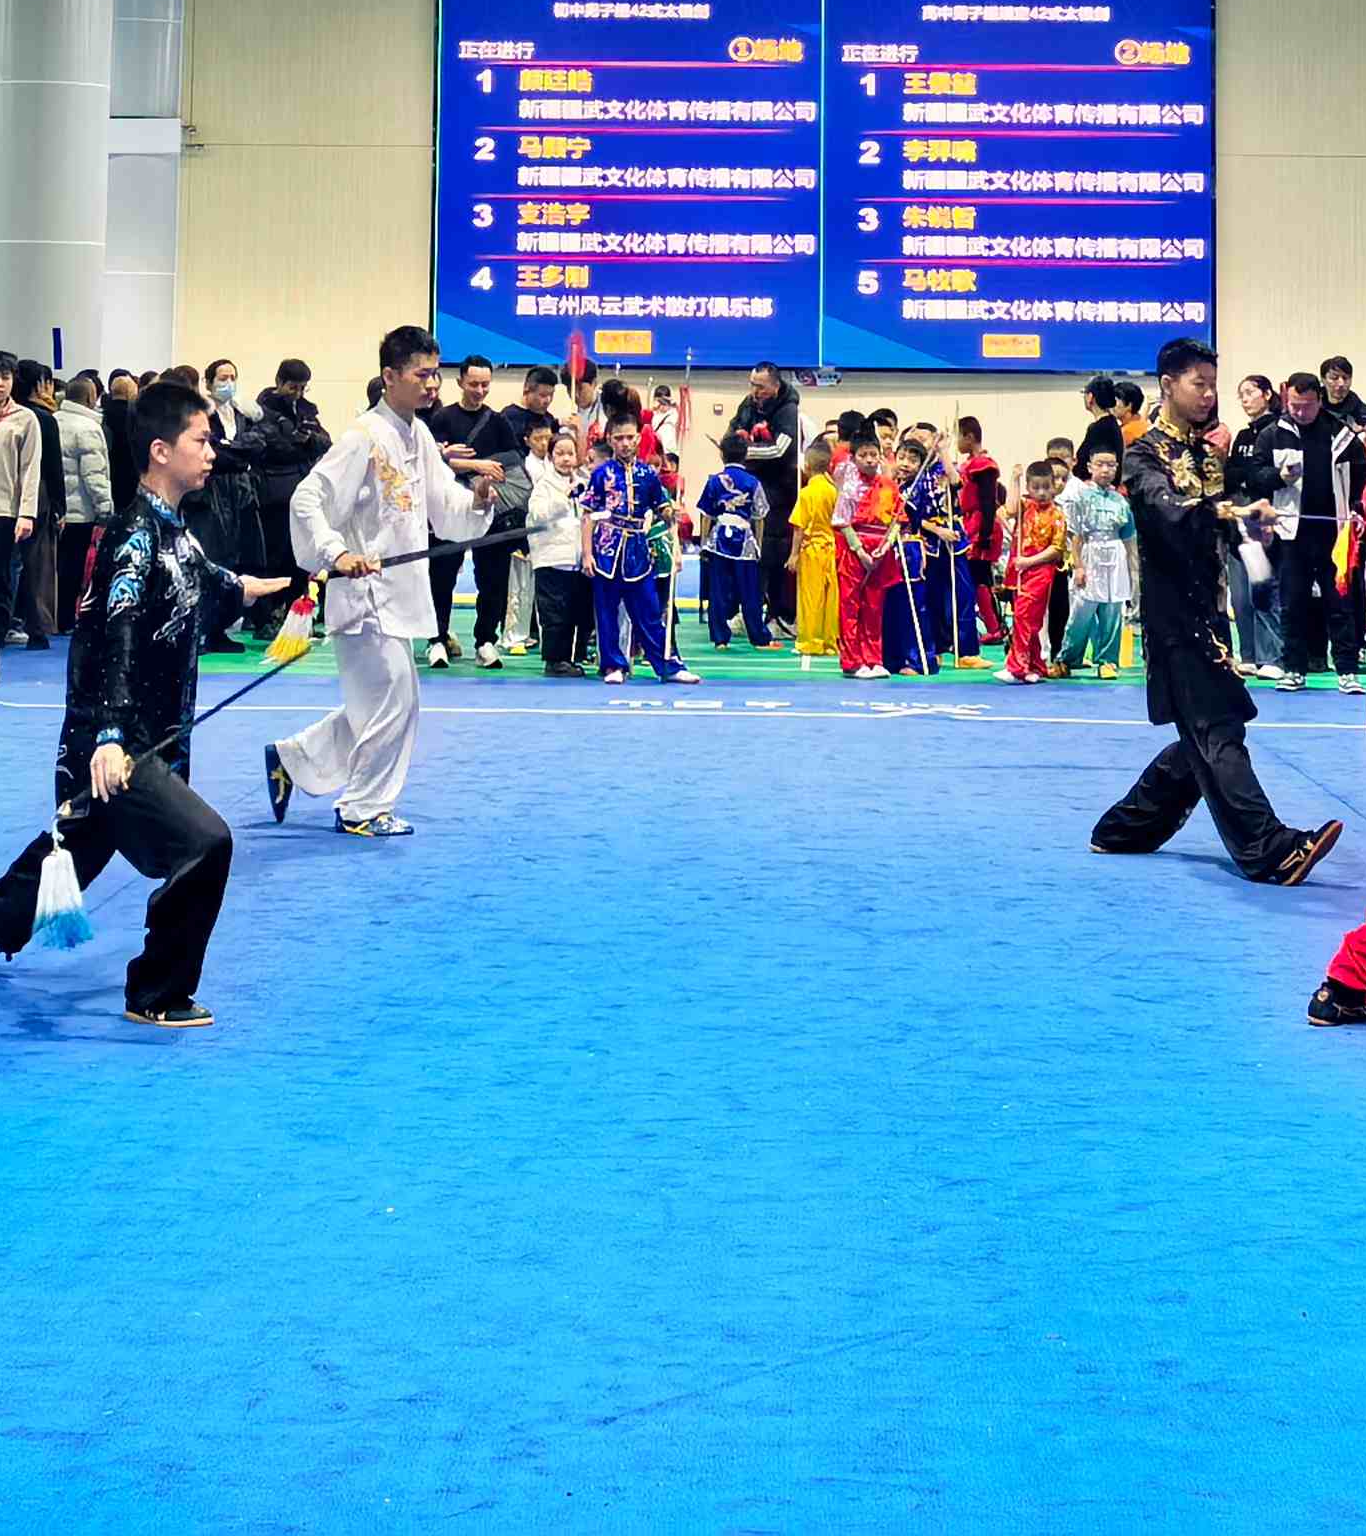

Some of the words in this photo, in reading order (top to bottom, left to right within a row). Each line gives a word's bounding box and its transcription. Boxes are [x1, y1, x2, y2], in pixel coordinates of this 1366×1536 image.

[460, 42, 534, 59] 正在进行
[843, 45, 918, 62] 正在进行
[477, 70, 491, 93] 1
[861, 74, 874, 96] 1
[475, 138, 494, 160] 2
[860, 142, 879, 164] 2
[474, 205, 492, 227] 3
[859, 209, 878, 231] 3
[471, 268, 492, 290] 4
[858, 271, 878, 294] 5
